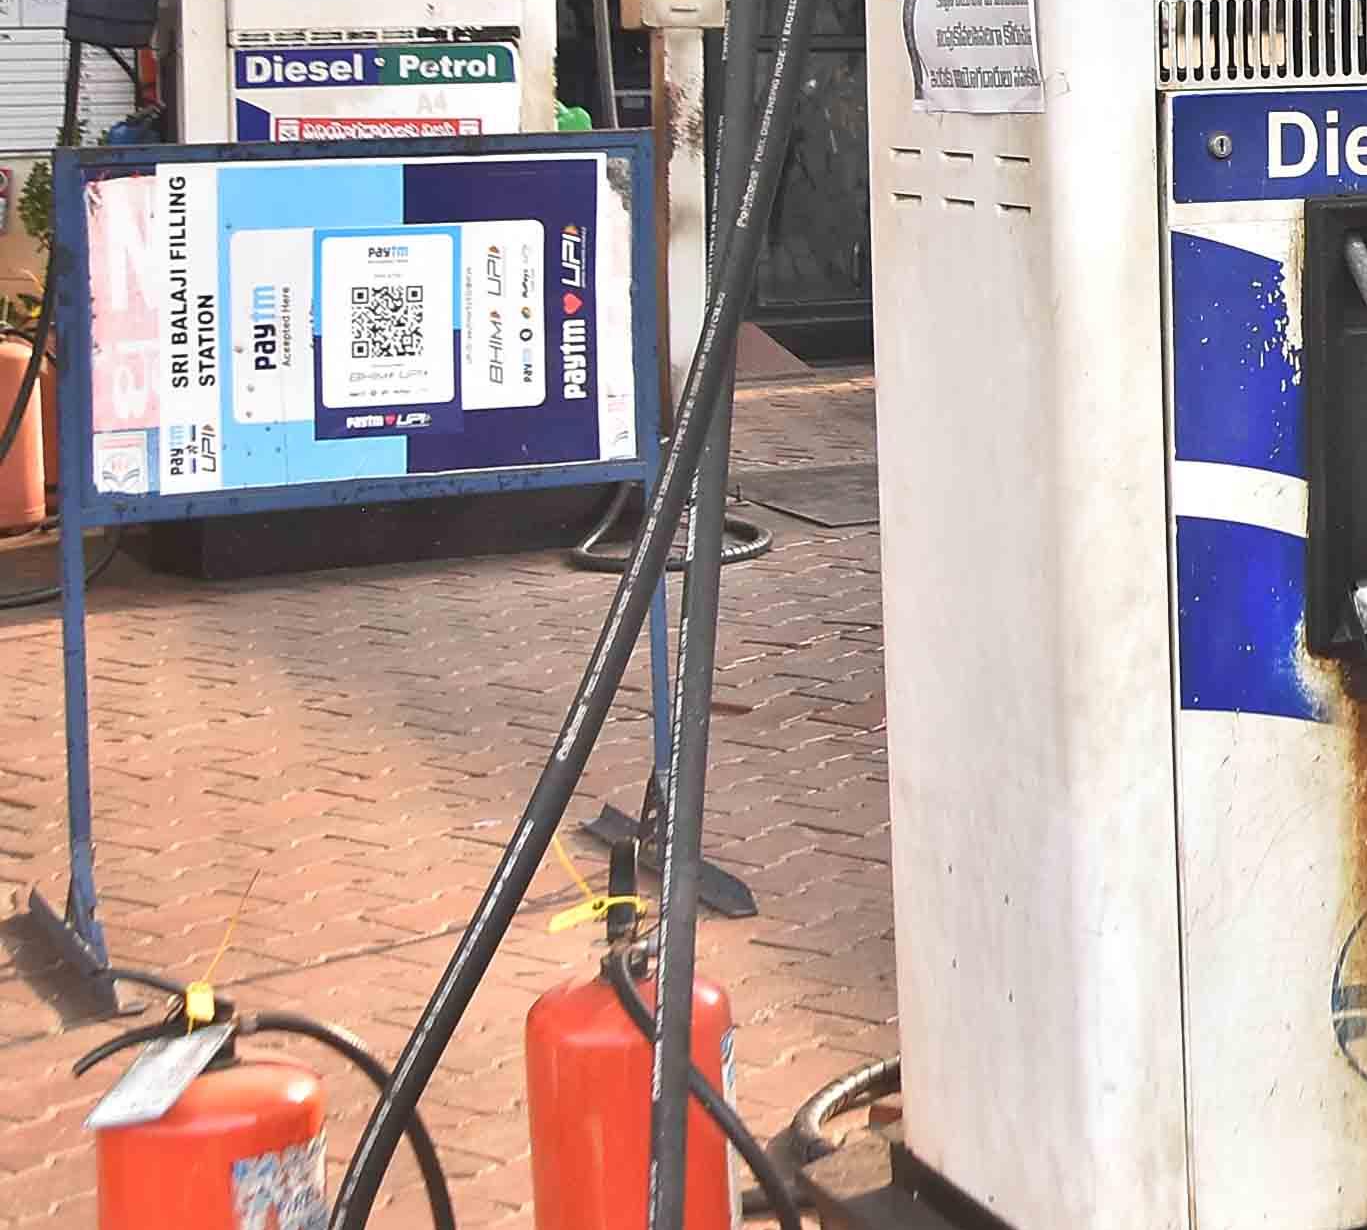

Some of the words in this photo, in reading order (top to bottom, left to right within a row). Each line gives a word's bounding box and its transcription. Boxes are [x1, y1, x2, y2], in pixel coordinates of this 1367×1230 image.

[245, 53, 363, 83] Diesel
[400, 53, 497, 79] Petrol
[169, 175, 187, 261] FILLING
[368, 246, 408, 258] paytm
[487, 255, 502, 297] UPI
[561, 233, 586, 288] UPI
[170, 270, 188, 346] BALAJI
[282, 286, 290, 315] Here
[197, 294, 216, 387] STATION
[252, 285, 276, 370] paytm
[282, 318, 291, 367] Accepted
[489, 317, 504, 384] BHIM
[172, 360, 188, 388] SRI
[560, 319, 588, 400] paytm
[169, 424, 185, 476] paytm
